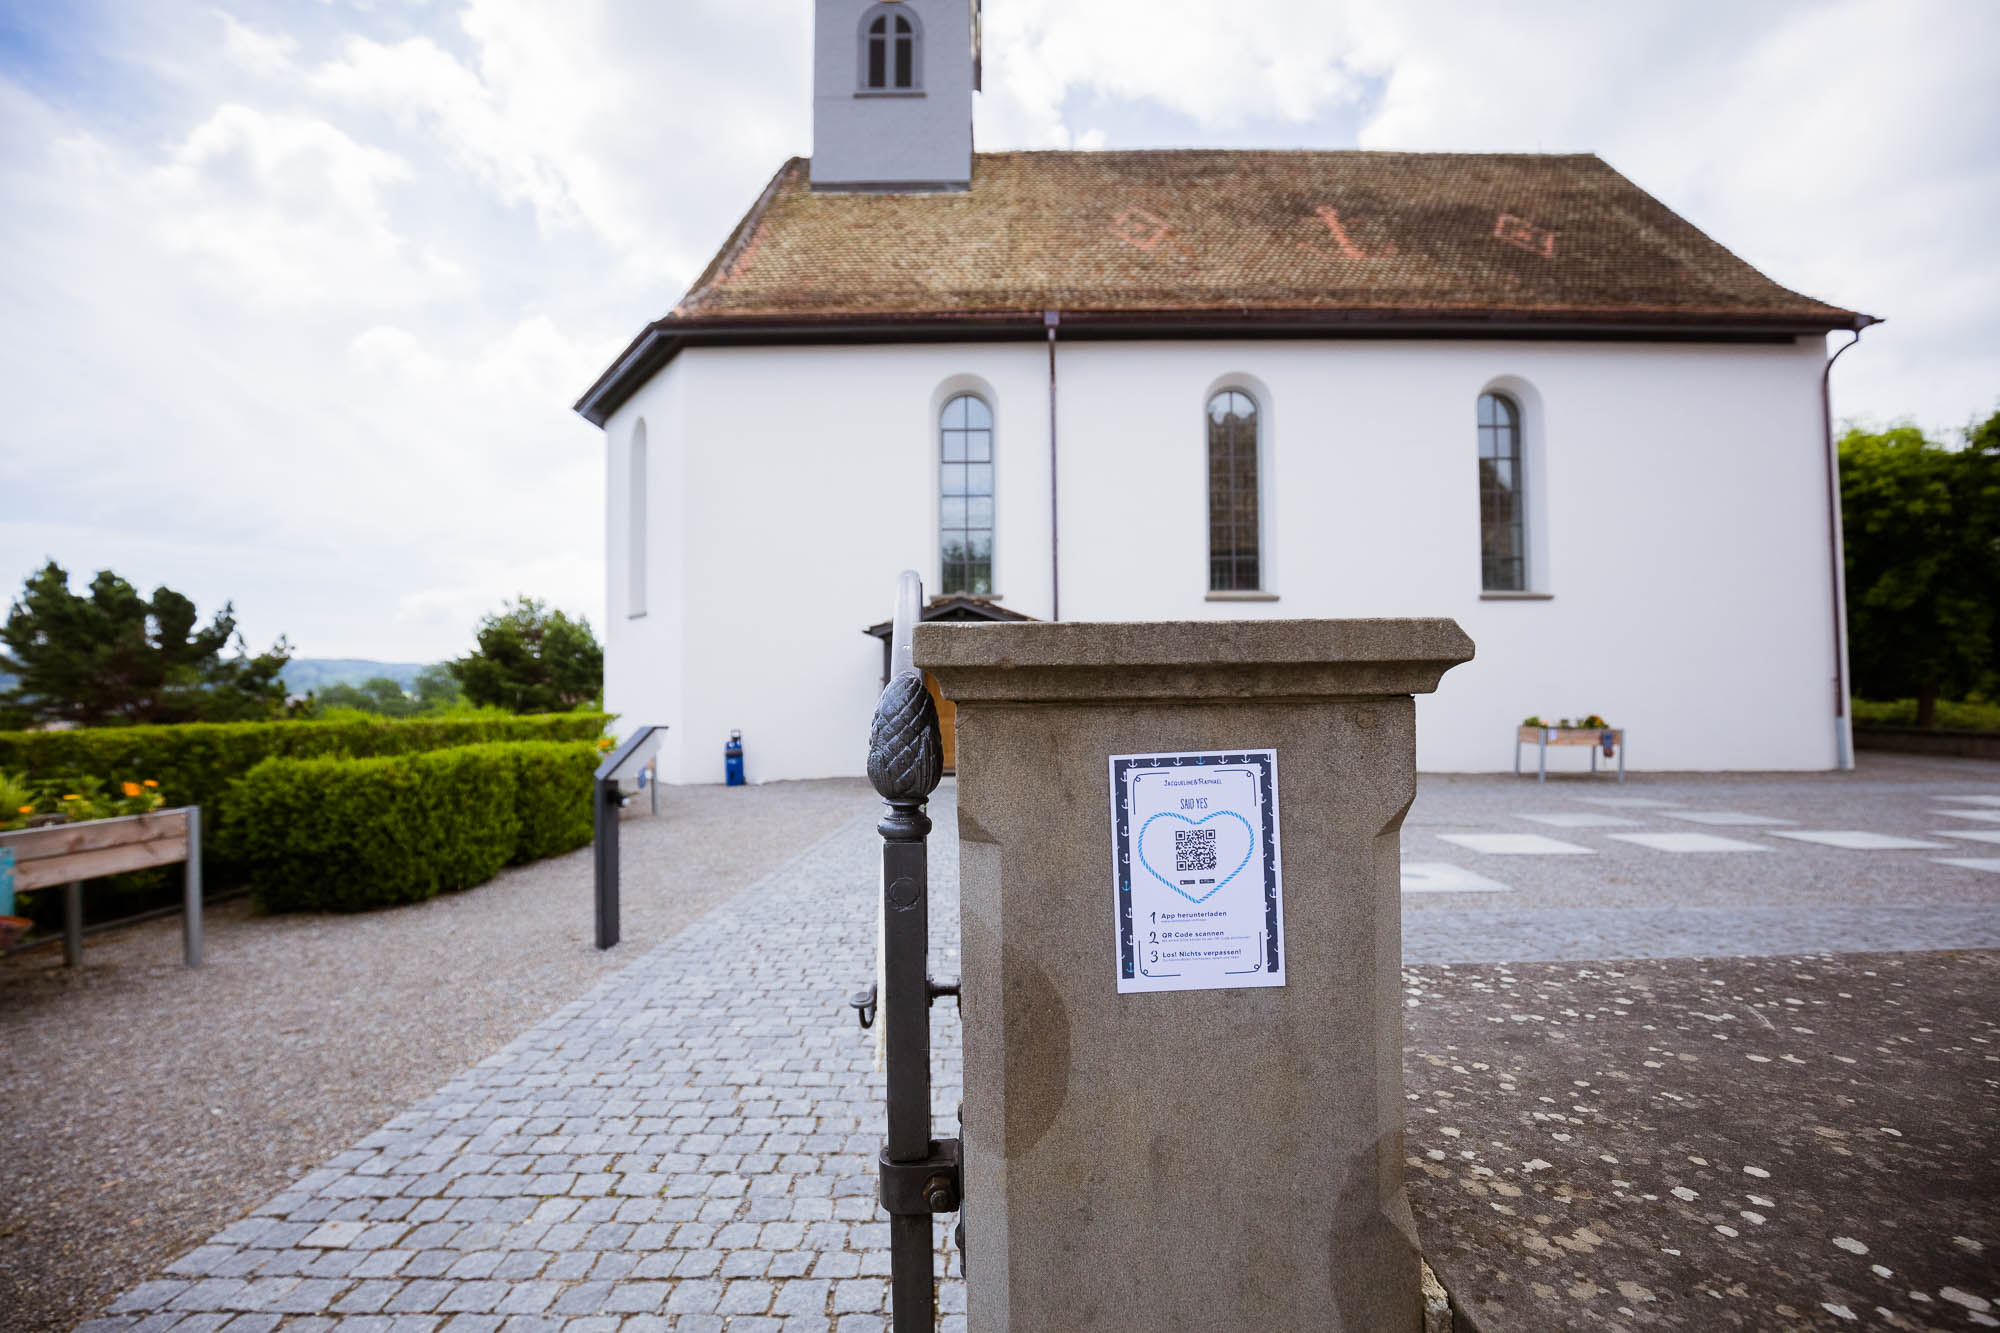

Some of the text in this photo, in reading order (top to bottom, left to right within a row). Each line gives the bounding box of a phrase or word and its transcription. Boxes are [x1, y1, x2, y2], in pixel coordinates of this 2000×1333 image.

[1180, 797, 1208, 810] SAID YES
[1150, 911, 1156, 924] 1
[1149, 932, 1159, 944] 2
[1150, 950, 1158, 963] 3
[1203, 949, 1241, 957] verpassen!
